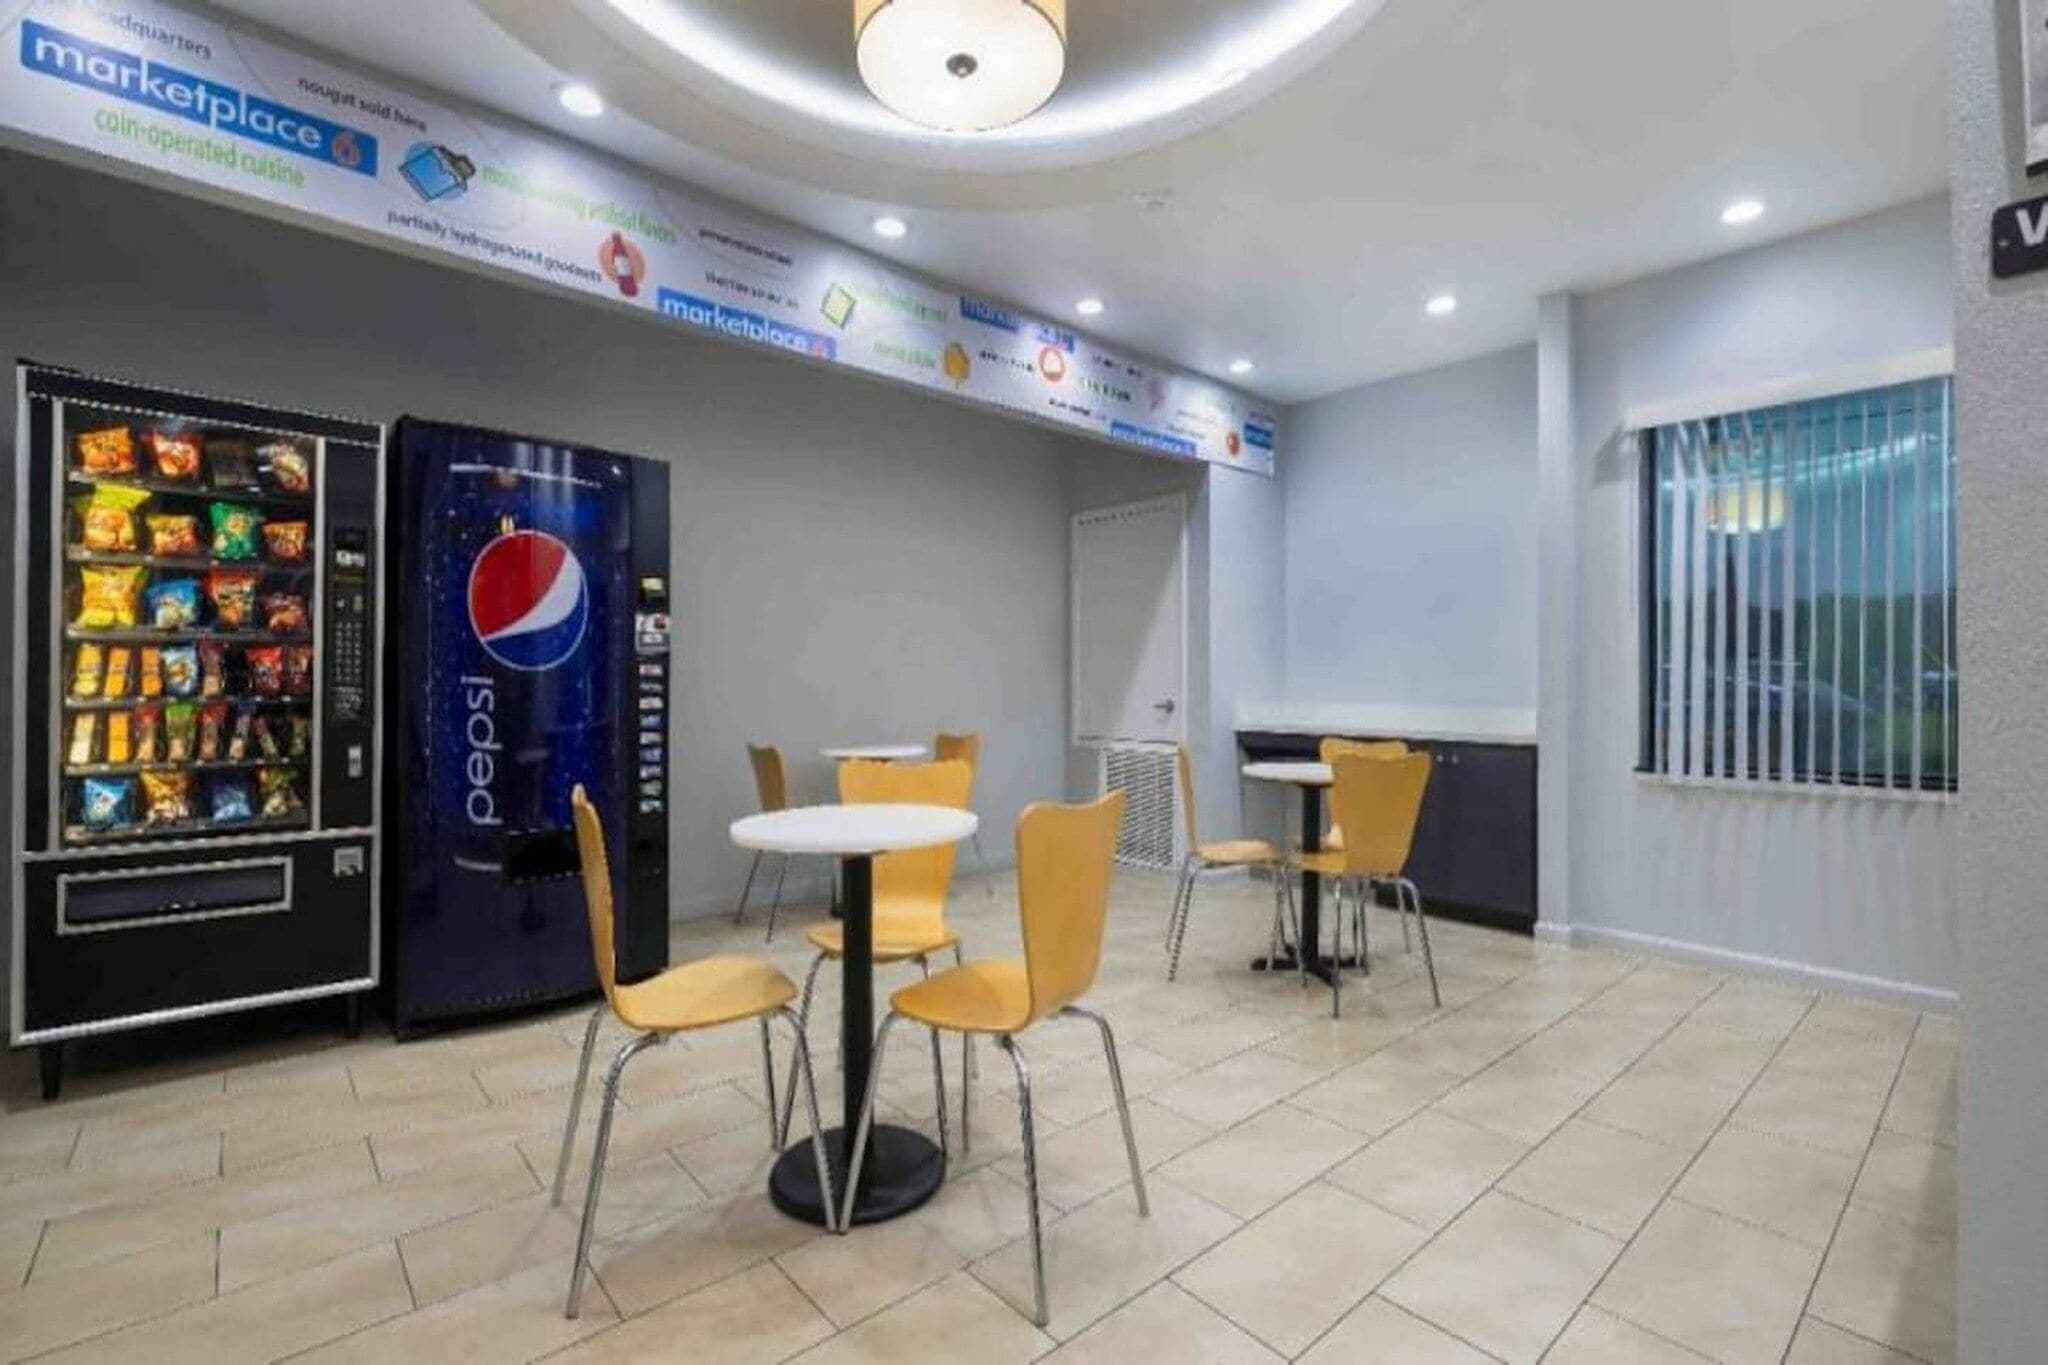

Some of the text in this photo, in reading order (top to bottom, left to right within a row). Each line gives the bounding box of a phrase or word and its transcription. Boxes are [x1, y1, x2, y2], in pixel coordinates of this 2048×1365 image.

[91, 7, 212, 60] adquarters
[35, 37, 322, 149] marketplace
[359, 99, 391, 120] sold
[93, 106, 306, 188] coin-operated cuisine
[664, 297, 809, 353] marketplace
[461, 676, 503, 827] pepsi
